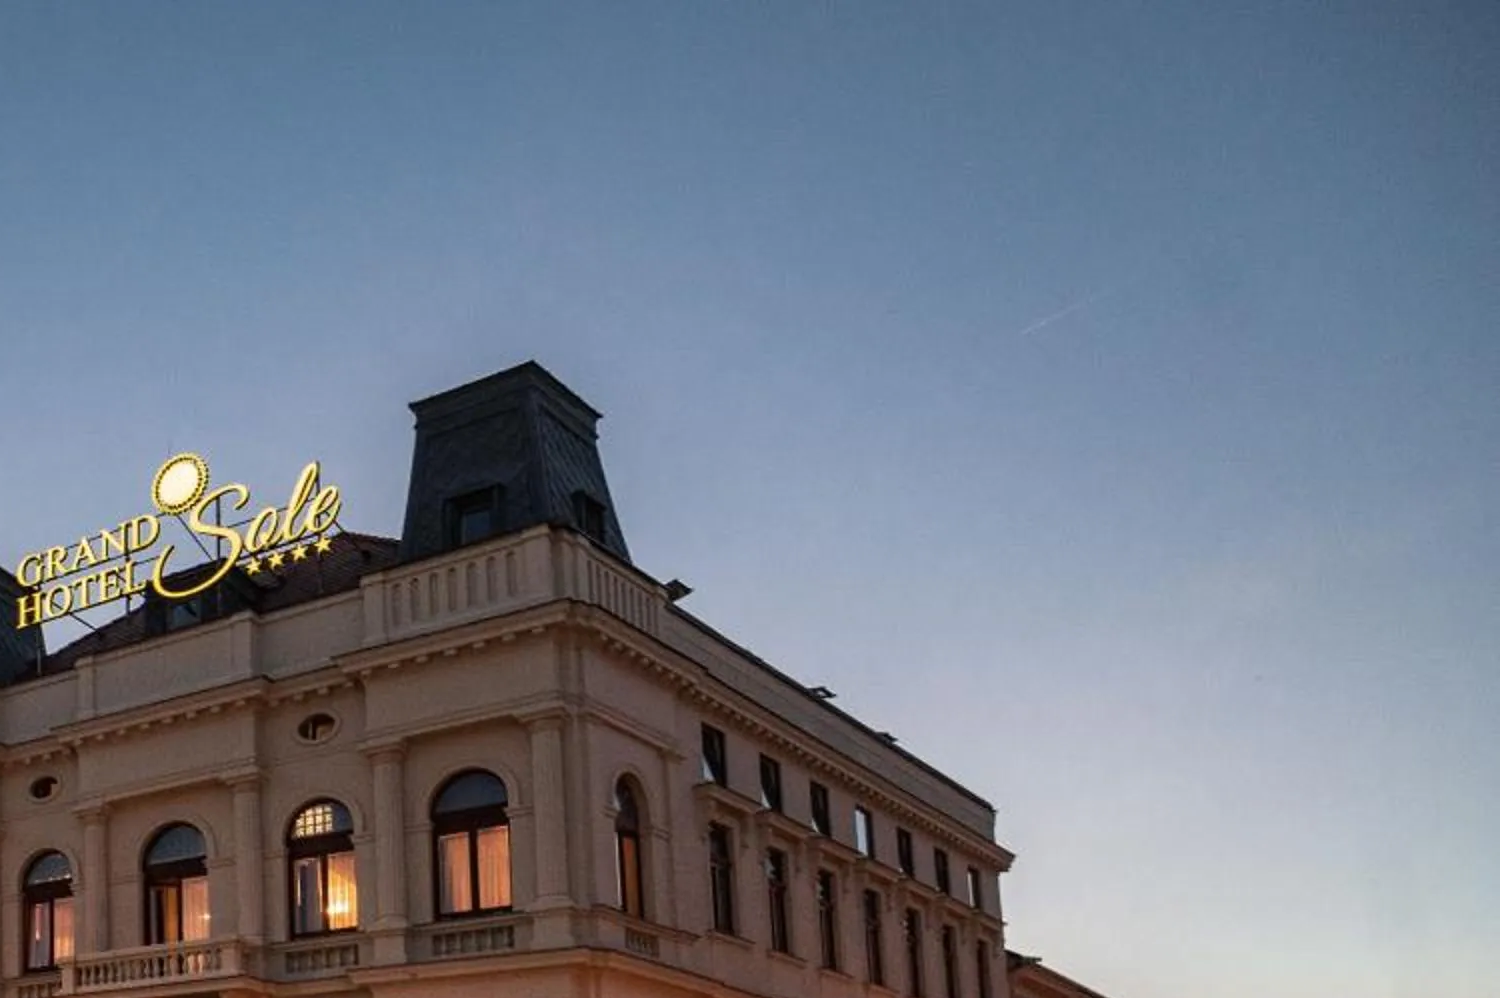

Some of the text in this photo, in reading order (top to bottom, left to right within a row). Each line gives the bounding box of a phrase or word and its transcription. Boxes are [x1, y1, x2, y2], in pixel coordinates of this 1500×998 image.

[15, 514, 161, 588] GRAND
[152, 461, 342, 598] Sole
[15, 560, 148, 629] HOTEL
